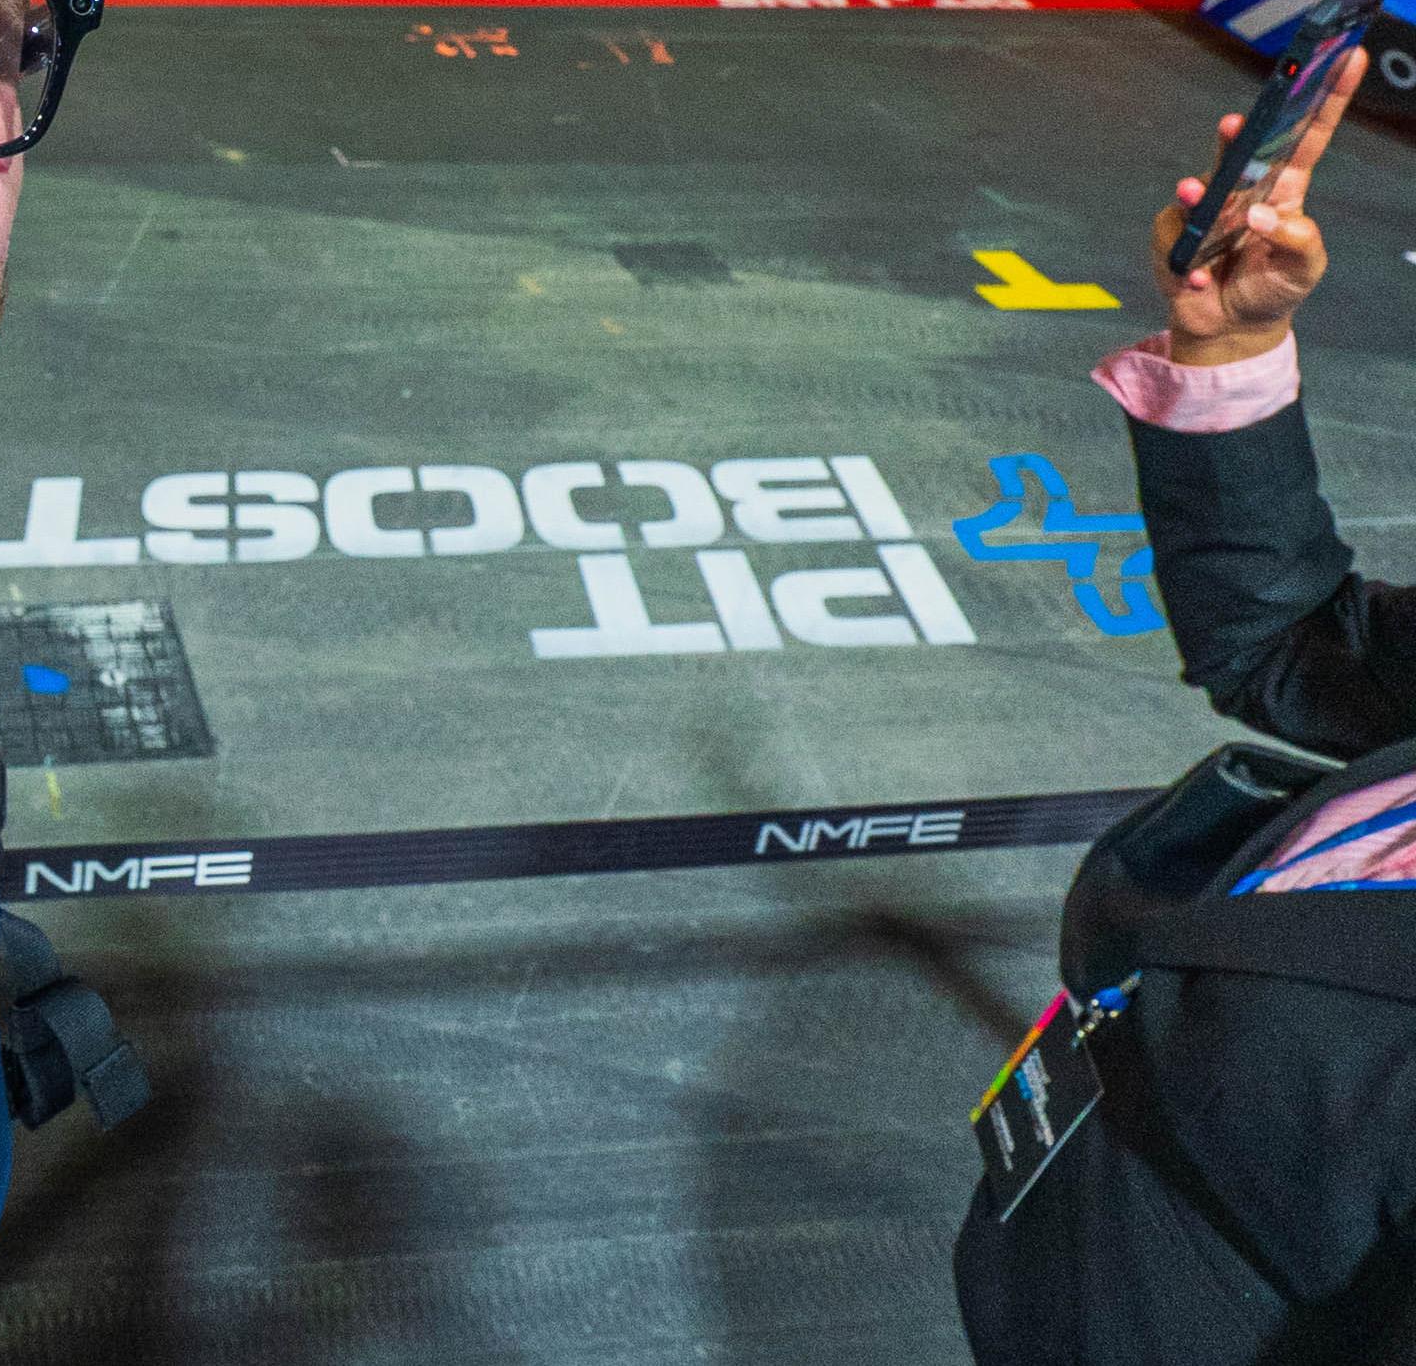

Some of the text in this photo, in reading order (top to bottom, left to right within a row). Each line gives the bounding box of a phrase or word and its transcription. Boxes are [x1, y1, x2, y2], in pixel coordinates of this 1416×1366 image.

[530, 543, 979, 659] PIT
[755, 810, 967, 856] NMFE
[24, 851, 255, 894] NMFE
